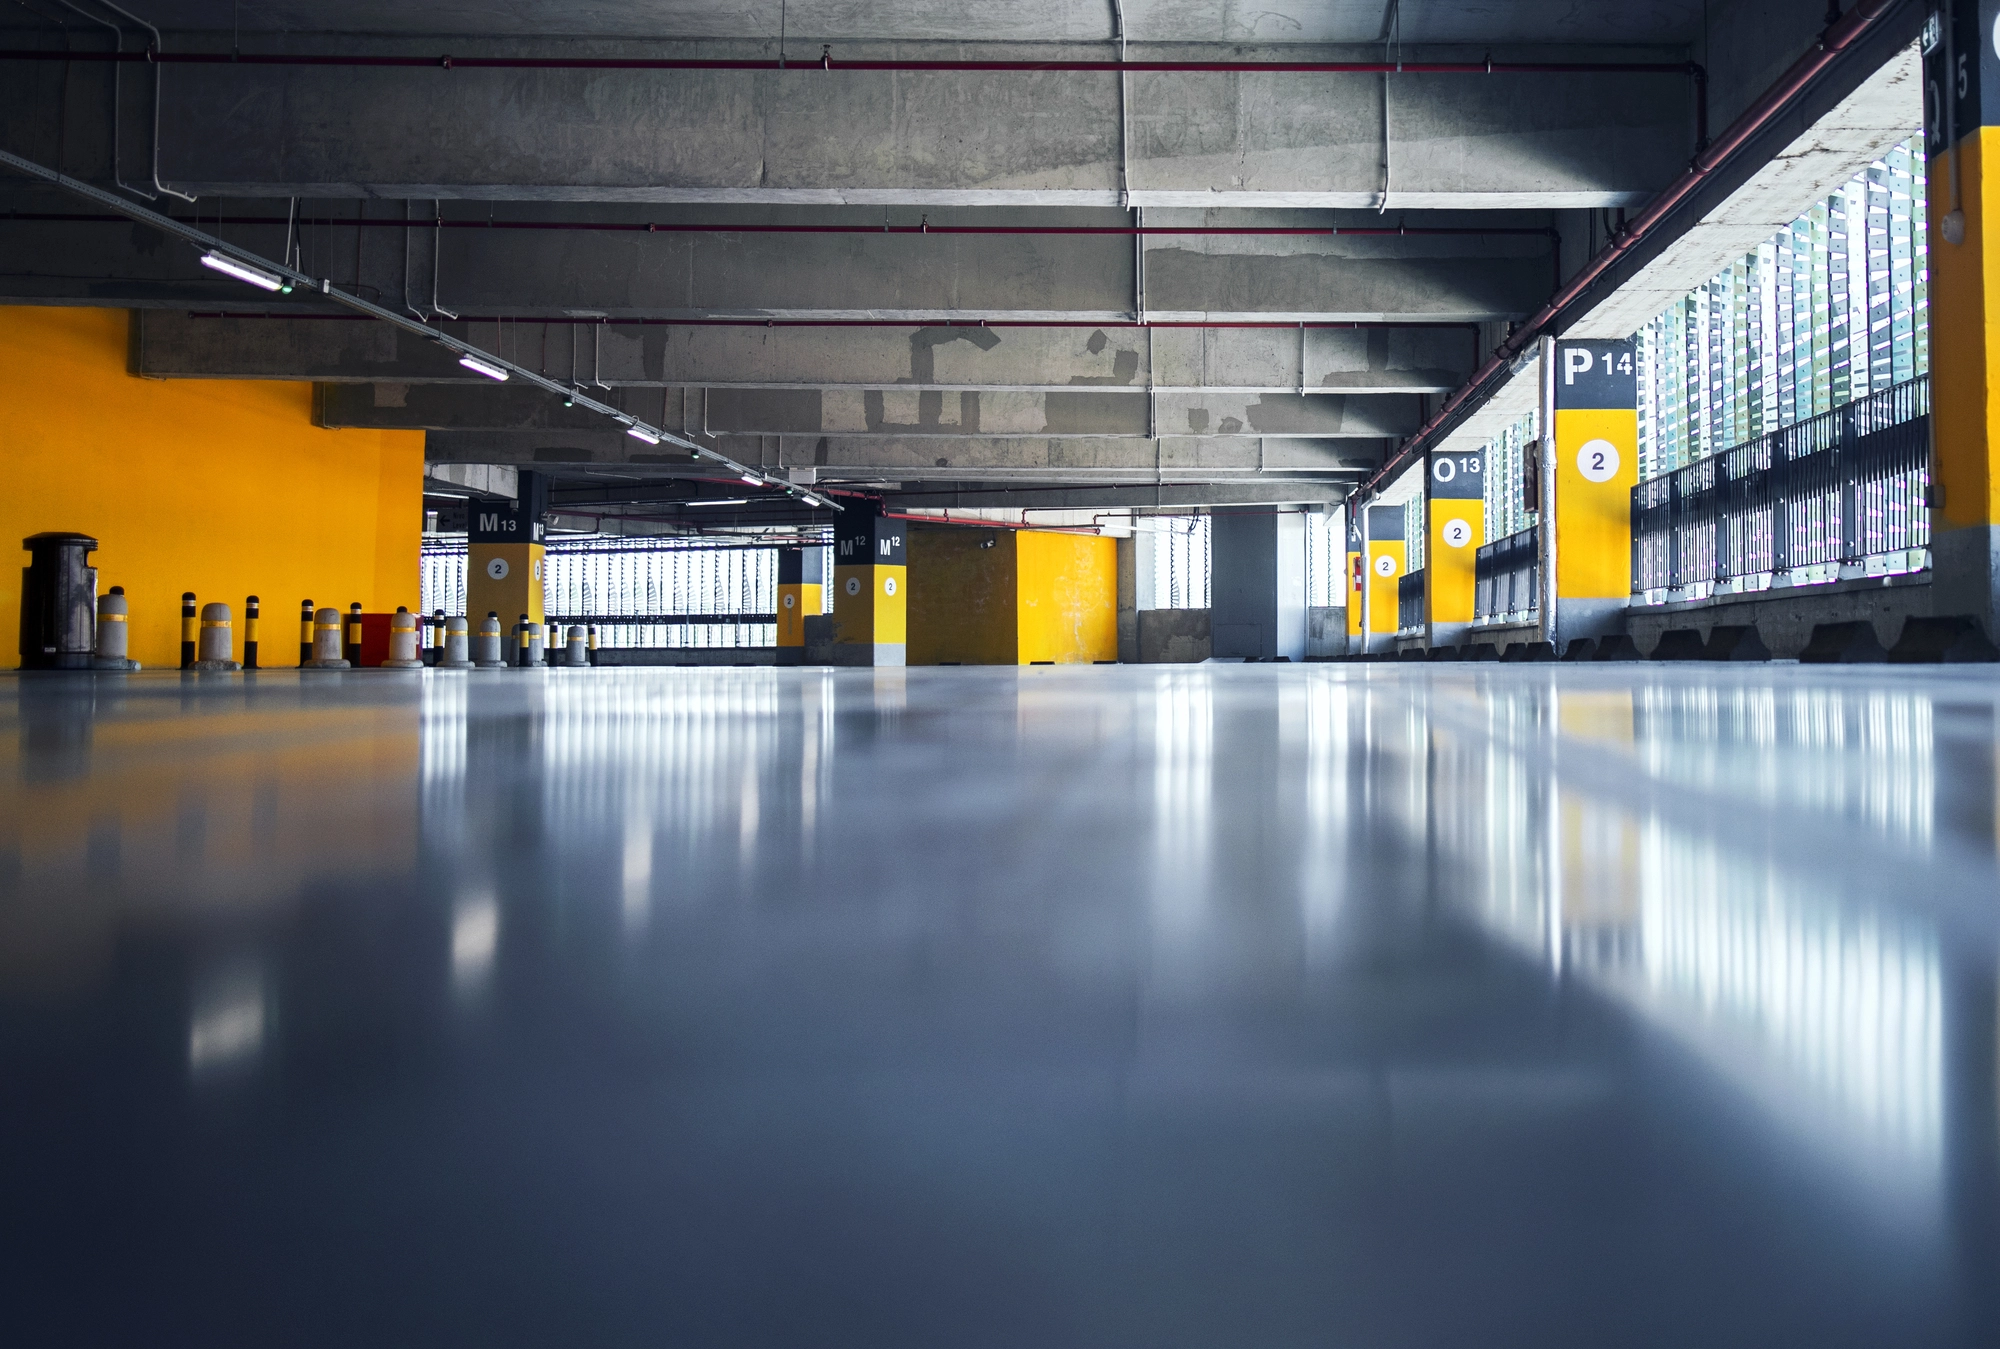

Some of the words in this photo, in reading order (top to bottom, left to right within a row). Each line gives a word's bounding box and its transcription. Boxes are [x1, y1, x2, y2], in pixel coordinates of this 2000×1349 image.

[1564, 348, 1593, 385] P
[1601, 352, 1633, 375] 14
[1592, 452, 1604, 470] 2
[1433, 457, 1456, 482] O
[1459, 457, 1480, 473] 13
[480, 513, 498, 531] M
[501, 520, 517, 531] 13
[533, 522, 539, 541] M
[539, 523, 544, 536] 13
[1453, 527, 1462, 540] 2
[840, 539, 854, 556] M
[854, 535, 866, 546] 12
[880, 539, 891, 556] M
[891, 536, 901, 547] 12
[494, 564, 502, 574] 2
[536, 566, 540, 575] 2
[1382, 561, 1389, 571] 2
[850, 582, 856, 591] 2
[888, 582, 893, 591] 2
[787, 597, 792, 605] 2
